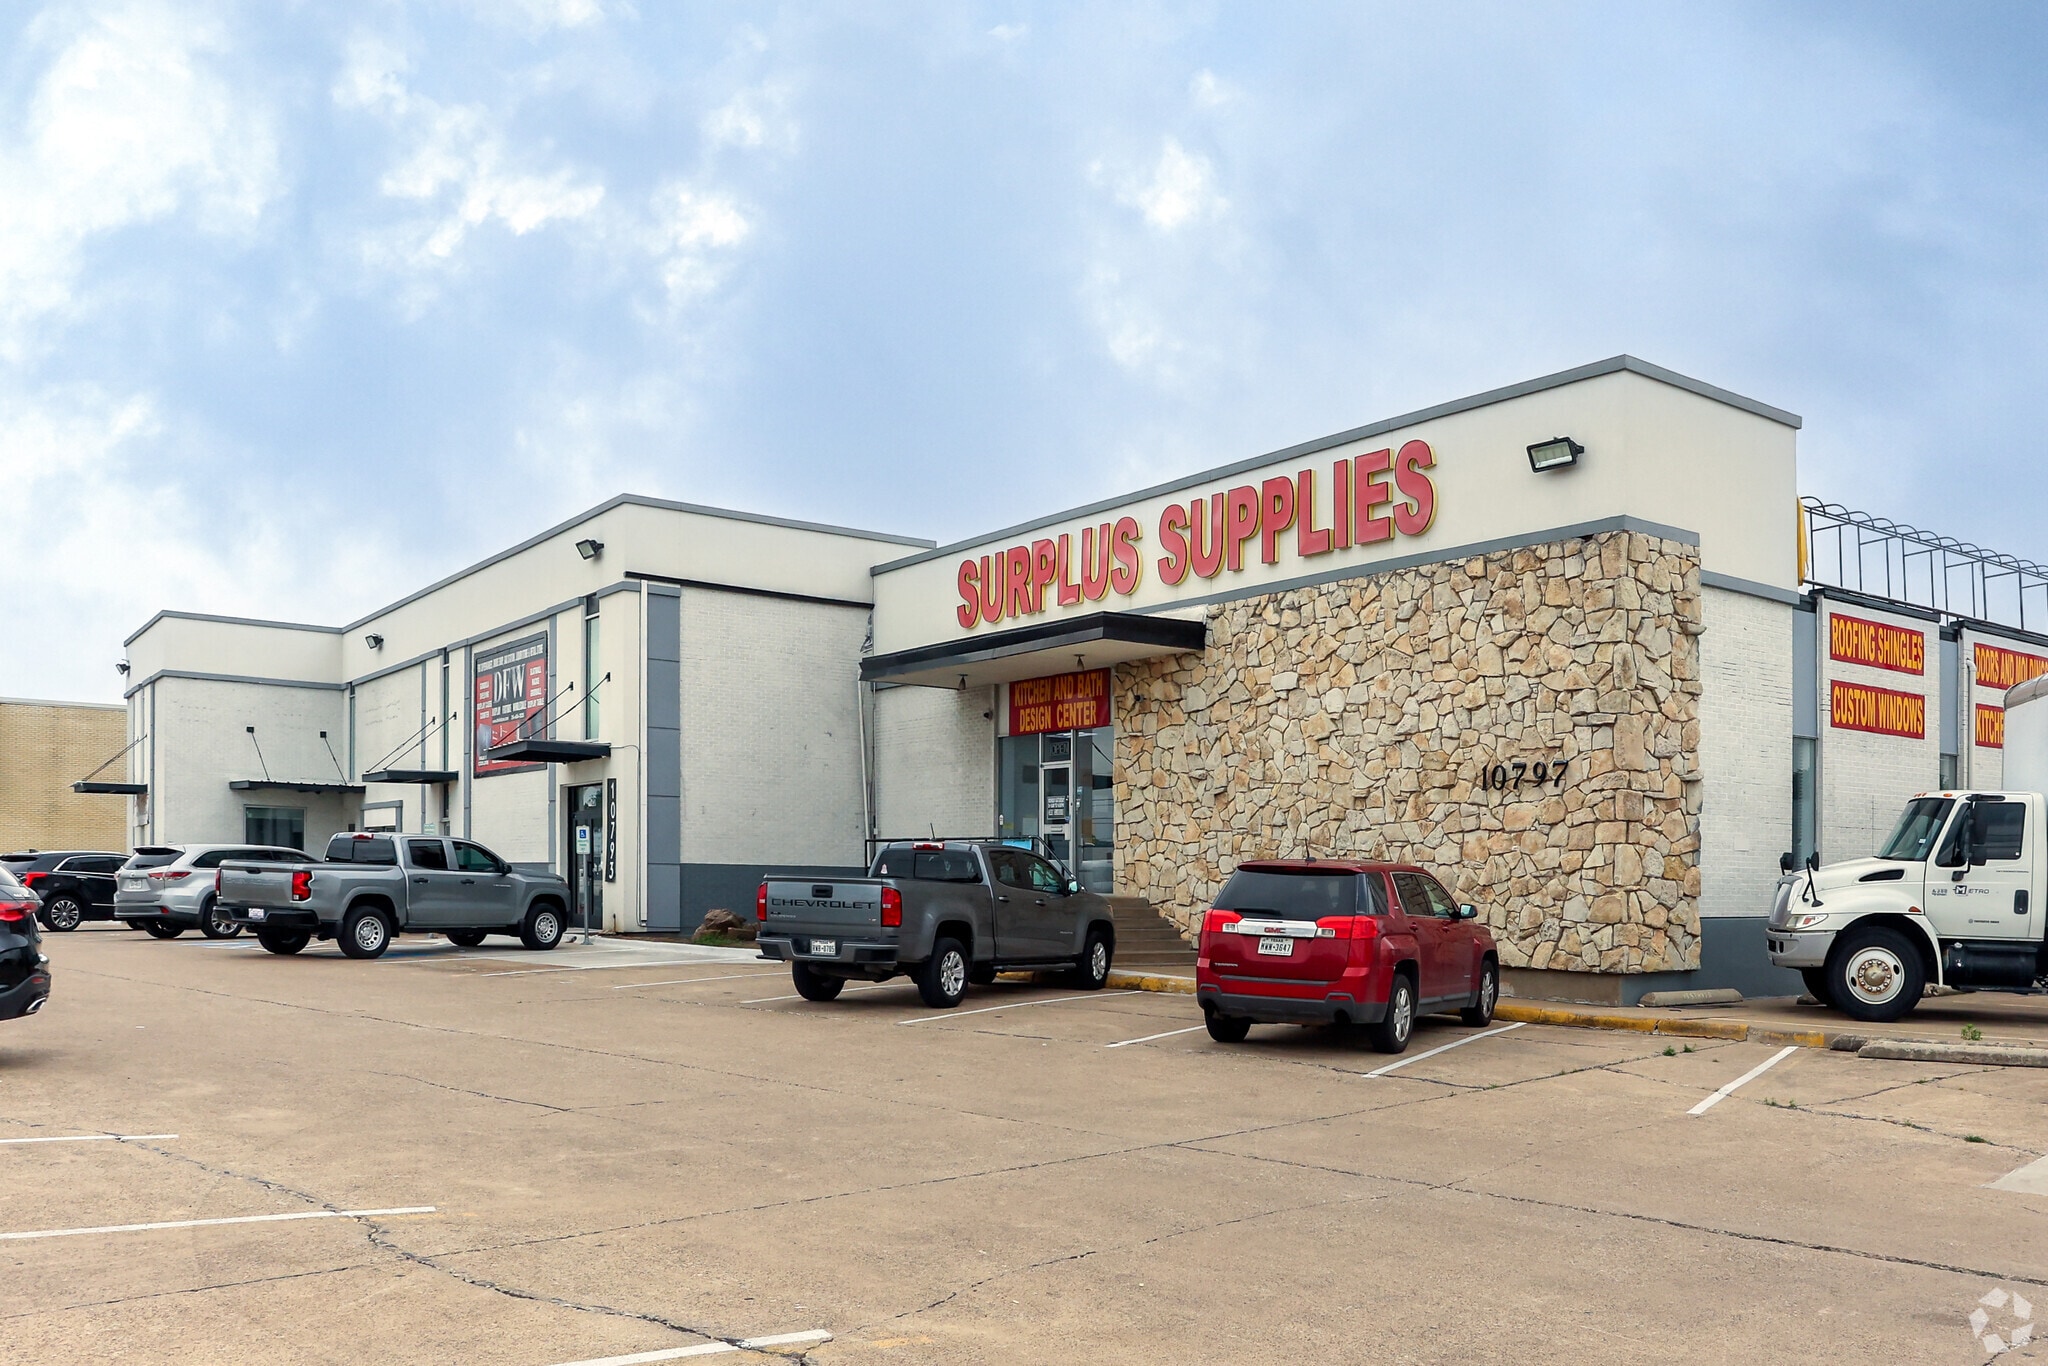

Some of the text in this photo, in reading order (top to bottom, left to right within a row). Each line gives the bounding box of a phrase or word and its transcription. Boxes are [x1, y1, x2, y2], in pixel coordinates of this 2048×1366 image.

[957, 439, 1437, 629] SURPLUS SUPPLIES
[1831, 617, 1923, 671] ROOFING SHINGLES
[493, 663, 526, 703] DFW
[1975, 647, 2000, 684] DOORS
[2000, 652, 2015, 686] AND
[1014, 672, 1103, 707] KITCHEN AND BATH
[1019, 701, 1097, 732] DESIGN CENTER
[1833, 685, 1923, 734] CUSTOM WINDOWS
[1976, 709, 2004, 744] KITCHE
[1481, 760, 1569, 791] 10797
[608, 782, 616, 879] 10793
[771, 898, 876, 909] CHEVROLET
